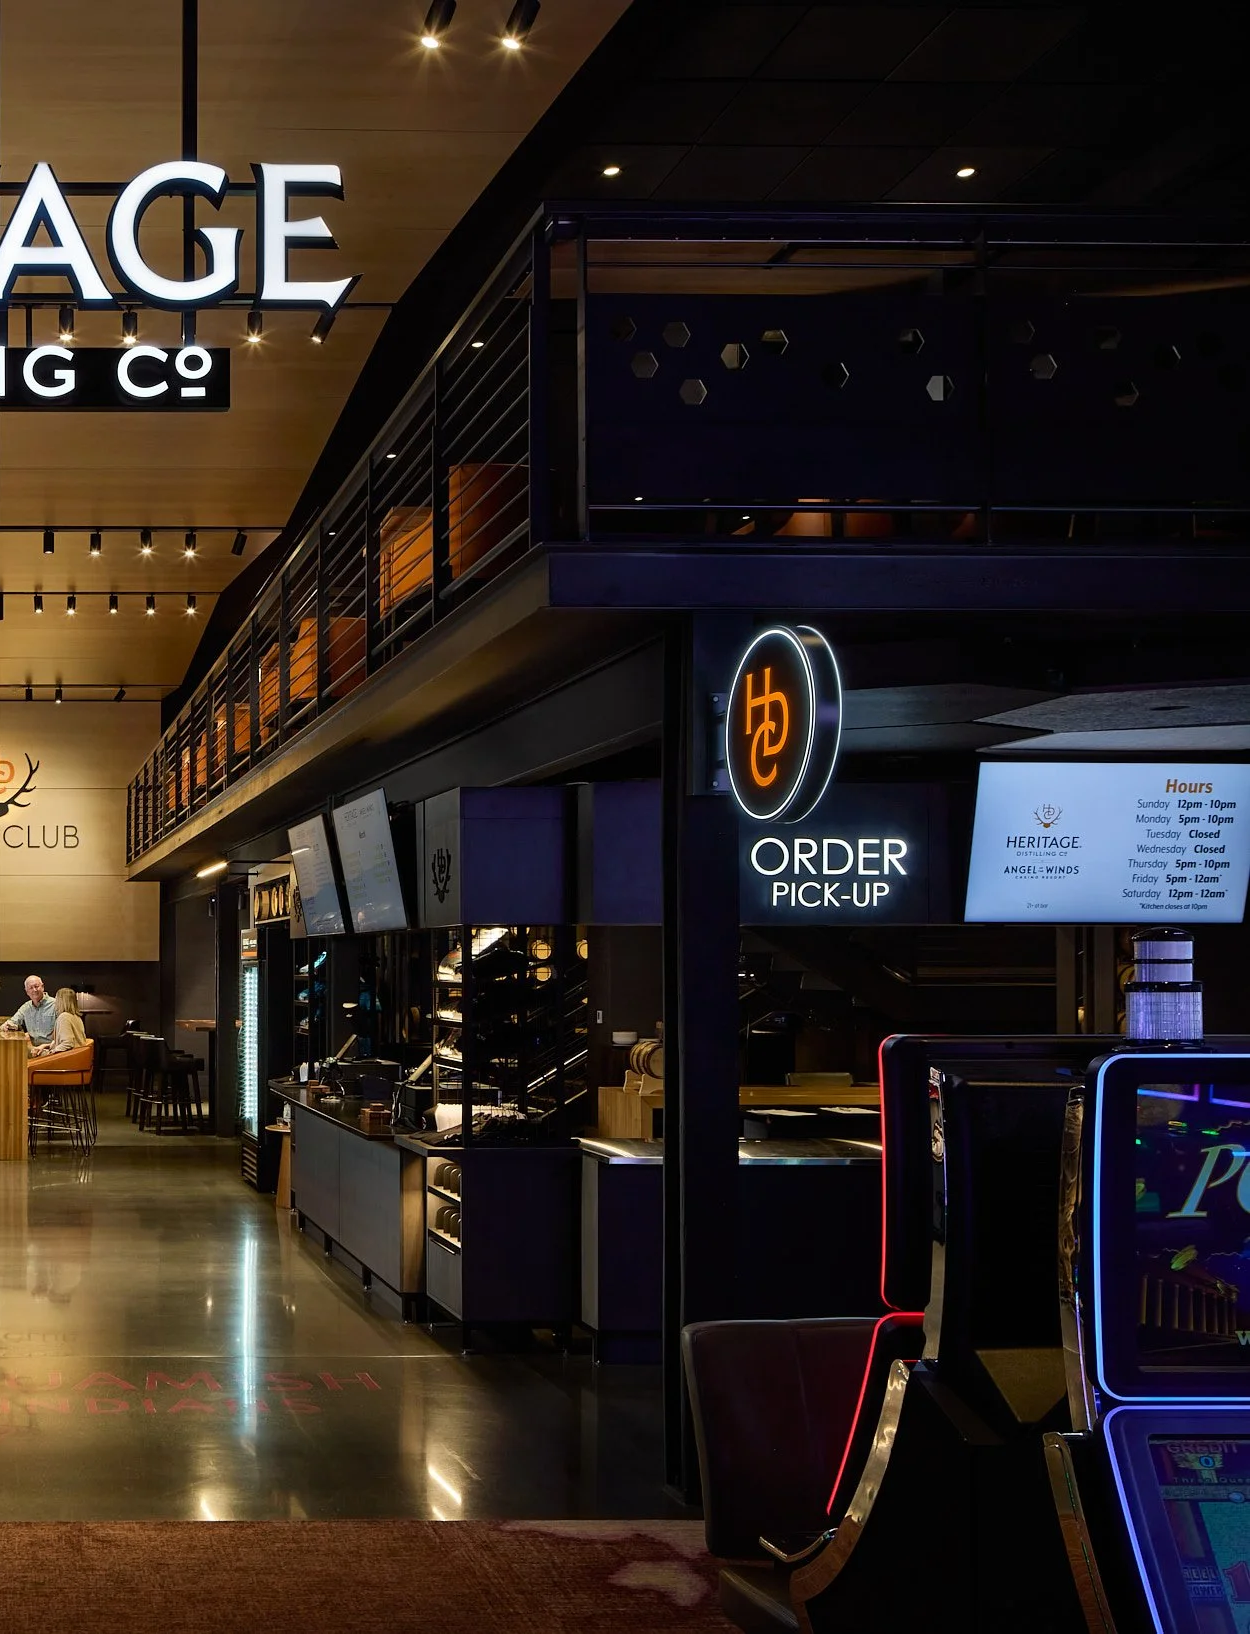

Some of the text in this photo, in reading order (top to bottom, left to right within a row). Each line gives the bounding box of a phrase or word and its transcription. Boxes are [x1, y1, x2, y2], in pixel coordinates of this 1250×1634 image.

[1165, 779, 1213, 793] Hours
[1137, 799, 1170, 811] Sunday
[1177, 799, 1202, 811] 12pm
[1210, 800, 1236, 811] 10pm
[1136, 814, 1171, 826] Monday
[1178, 815, 1200, 826] 5pm
[1208, 814, 1234, 826] 10pm
[3, 825, 80, 849] CLUB
[1146, 829, 1221, 841] Tuesday Closed
[1006, 836, 1080, 849] HERITAGE
[1137, 844, 1226, 856] Wednesday Closed
[750, 837, 909, 876] ORDER
[1004, 866, 1037, 874] ANGEL
[1046, 866, 1080, 875] WINDS
[1128, 859, 1168, 871] Thursday
[1175, 859, 1196, 871] 5pm
[1204, 859, 1230, 870] 10pm
[1132, 874, 1159, 885] Friday
[1166, 874, 1187, 885] 5pm
[771, 881, 890, 908] PICK-UP
[1122, 889, 1161, 900] Saturday
[1168, 889, 1193, 900] 12pm
